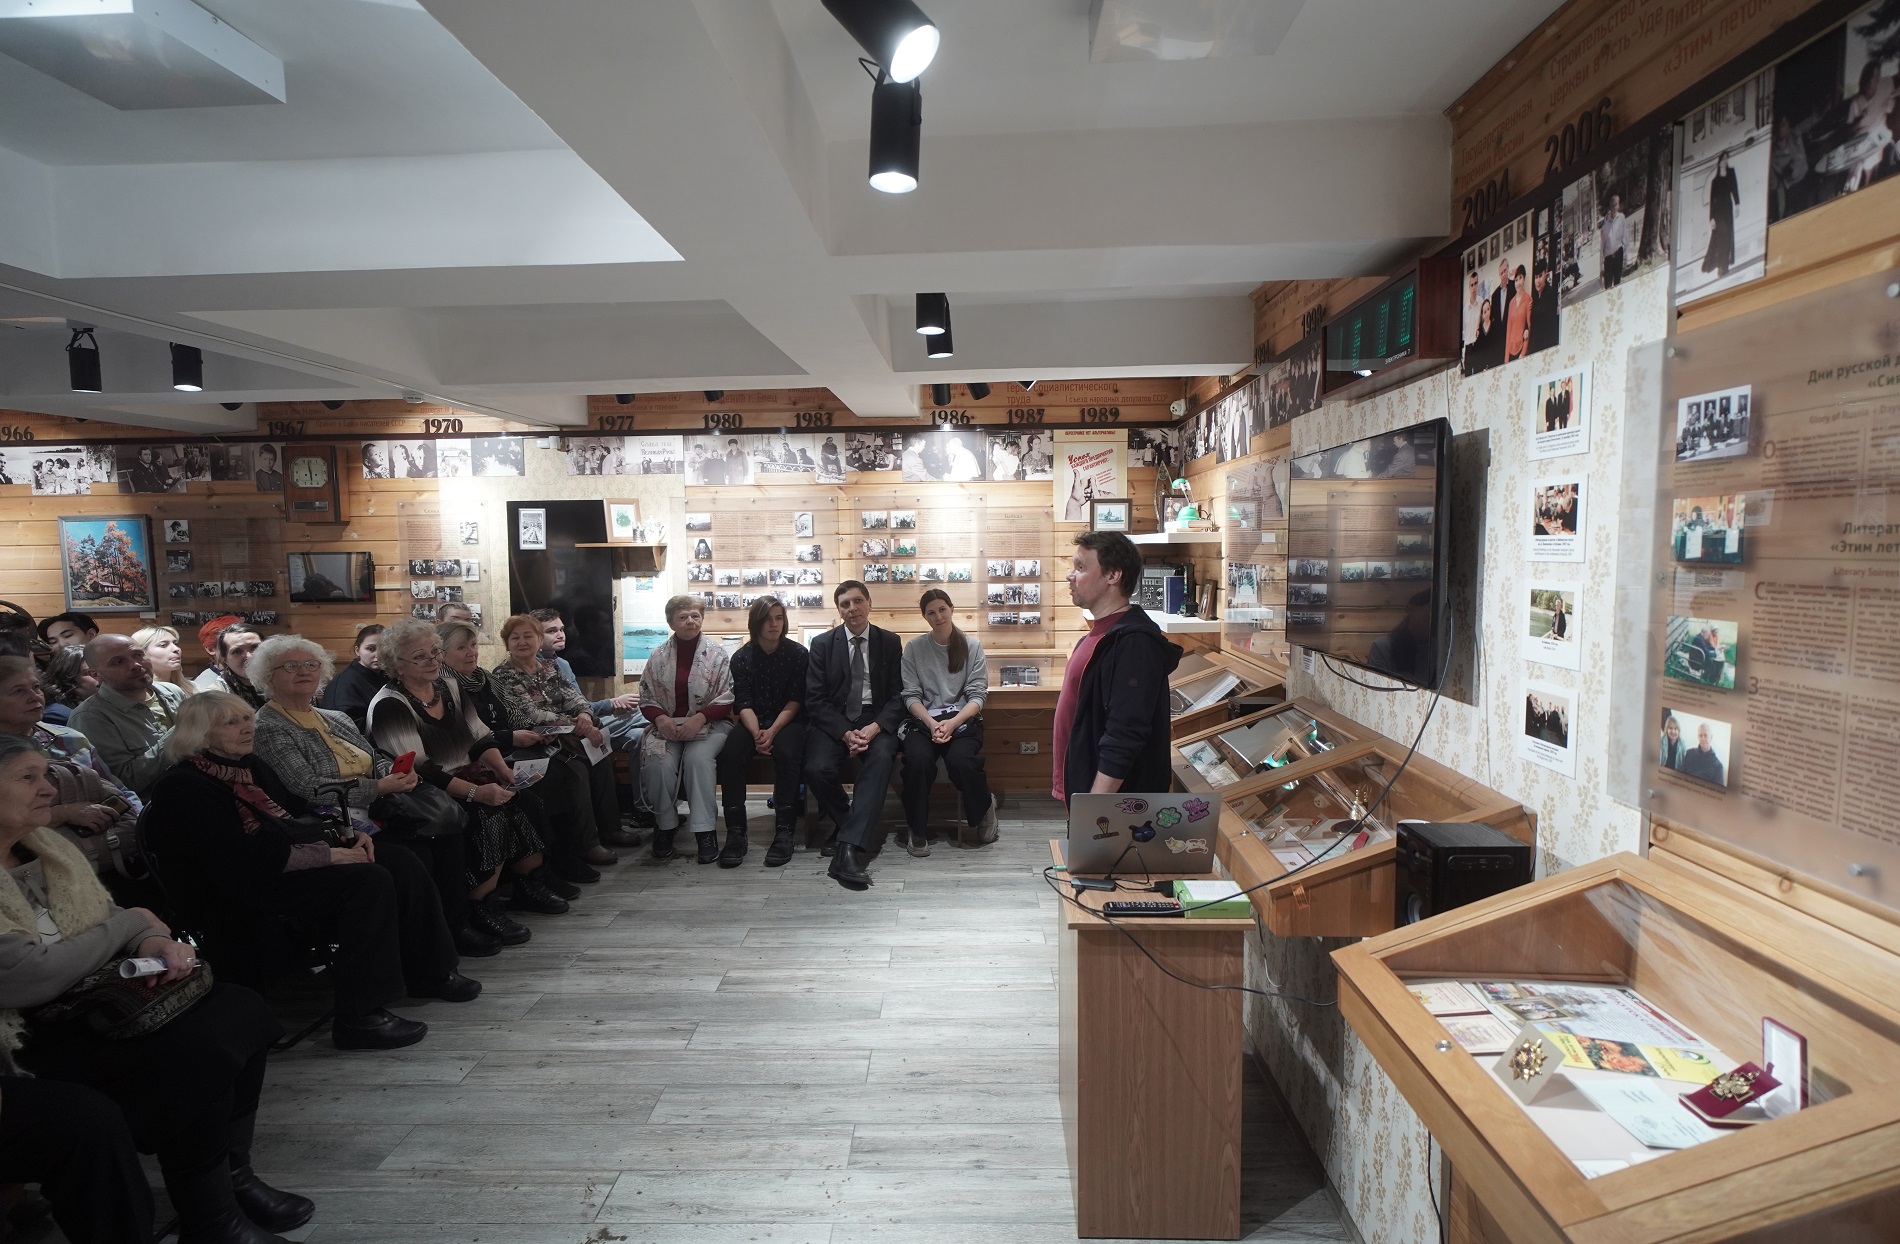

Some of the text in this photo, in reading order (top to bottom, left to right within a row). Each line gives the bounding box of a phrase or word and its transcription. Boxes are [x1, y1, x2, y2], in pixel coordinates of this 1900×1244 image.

[1664, 0, 1713, 38] Литер
[1549, 0, 1636, 81] Строительство
[1549, 63, 1590, 109] церкви
[1602, 5, 1663, 66] Усть-Уде
[1663, 27, 1713, 78] «Этим
[1461, 97, 1534, 168] Государственная
[1544, 96, 1613, 179] 2006
[1459, 130, 1526, 190] премия России
[1462, 168, 1512, 232] 2004
[1807, 368, 1834, 386] Дни
[1836, 353, 1891, 381] русской
[1034, 382, 1118, 393] Социалистического
[1006, 395, 1031, 406] труда
[1069, 396, 1088, 404] съезд
[1090, 396, 1120, 404] народных
[1121, 396, 1152, 404] депутатов
[359, 418, 390, 428] писателей
[391, 419, 406, 428] СССР
[597, 415, 635, 431] 1977
[701, 413, 742, 429] 1980
[793, 411, 834, 427] 1983
[929, 409, 970, 425] 1986
[1006, 408, 1046, 425] 1987
[1079, 407, 1120, 423] 1989
[1, 425, 35, 441] 966
[267, 420, 305, 436] 1967
[422, 418, 464, 433] 1970
[1842, 521, 1900, 538] Литерат
[1830, 539, 1900, 554] «Этим лет
[1833, 566, 1866, 578] Literary
